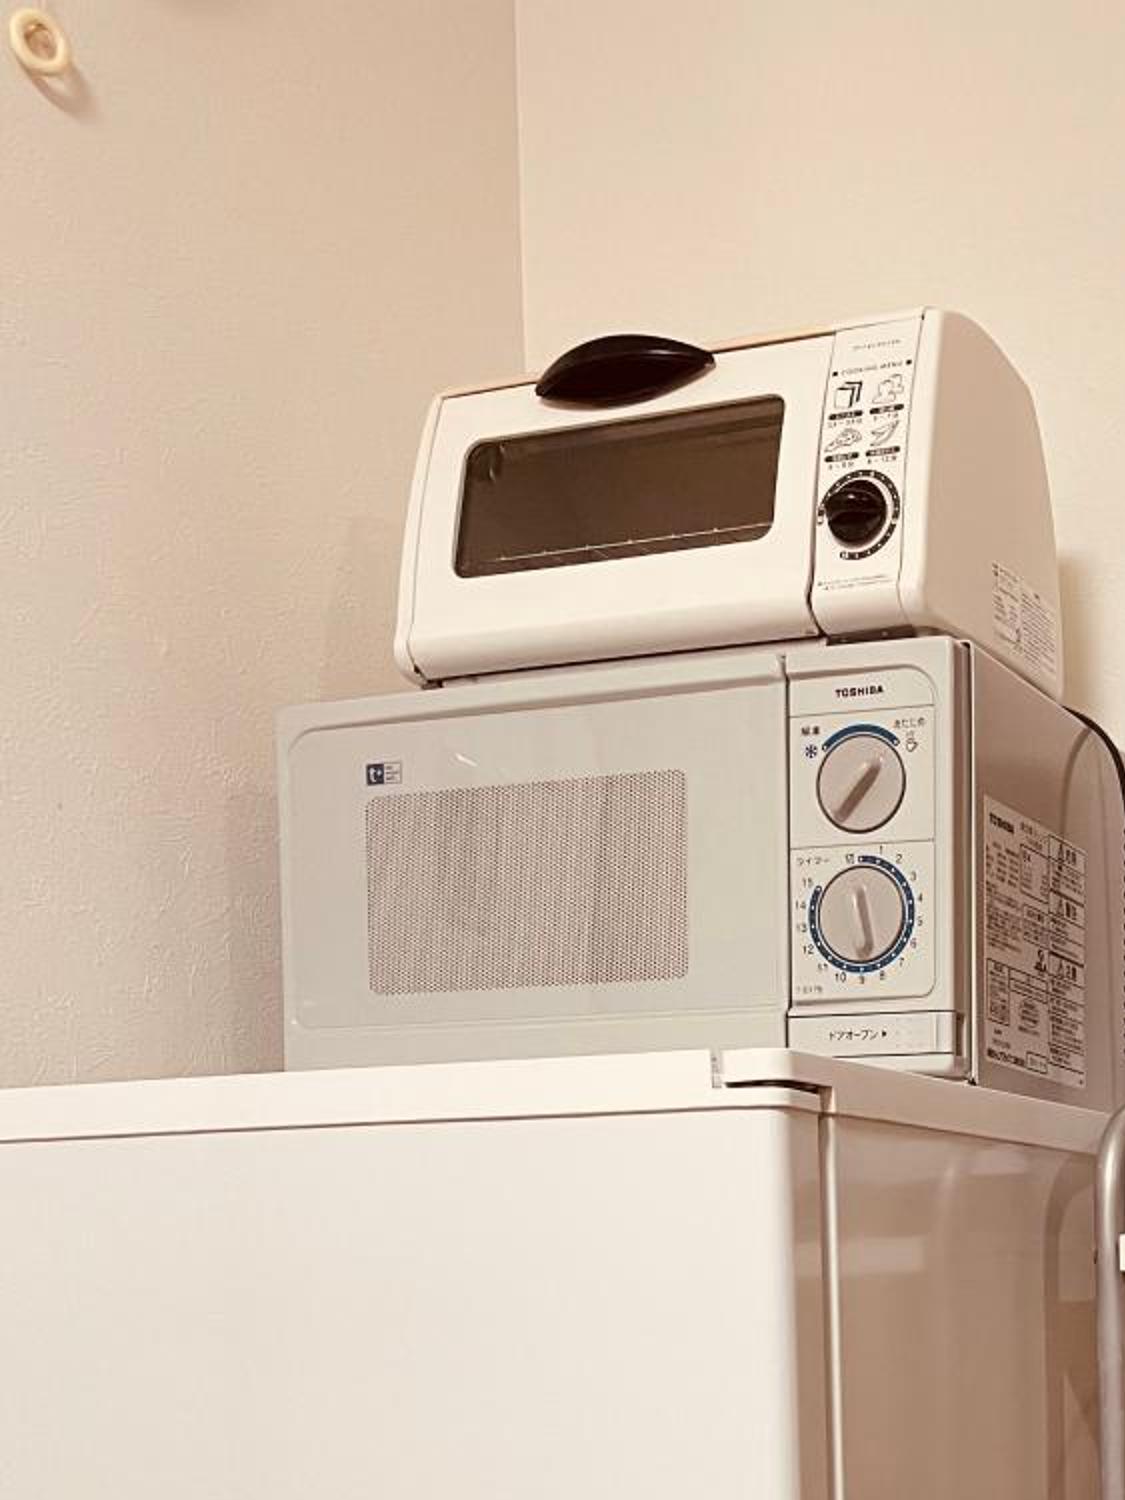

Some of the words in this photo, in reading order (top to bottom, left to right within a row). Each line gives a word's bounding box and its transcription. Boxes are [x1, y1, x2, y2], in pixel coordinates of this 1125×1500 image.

[835, 685, 884, 698] TOSHIBA
[803, 943, 814, 955] 12
[835, 972, 846, 983] 10
[829, 1028, 879, 1041] ドアオープン
